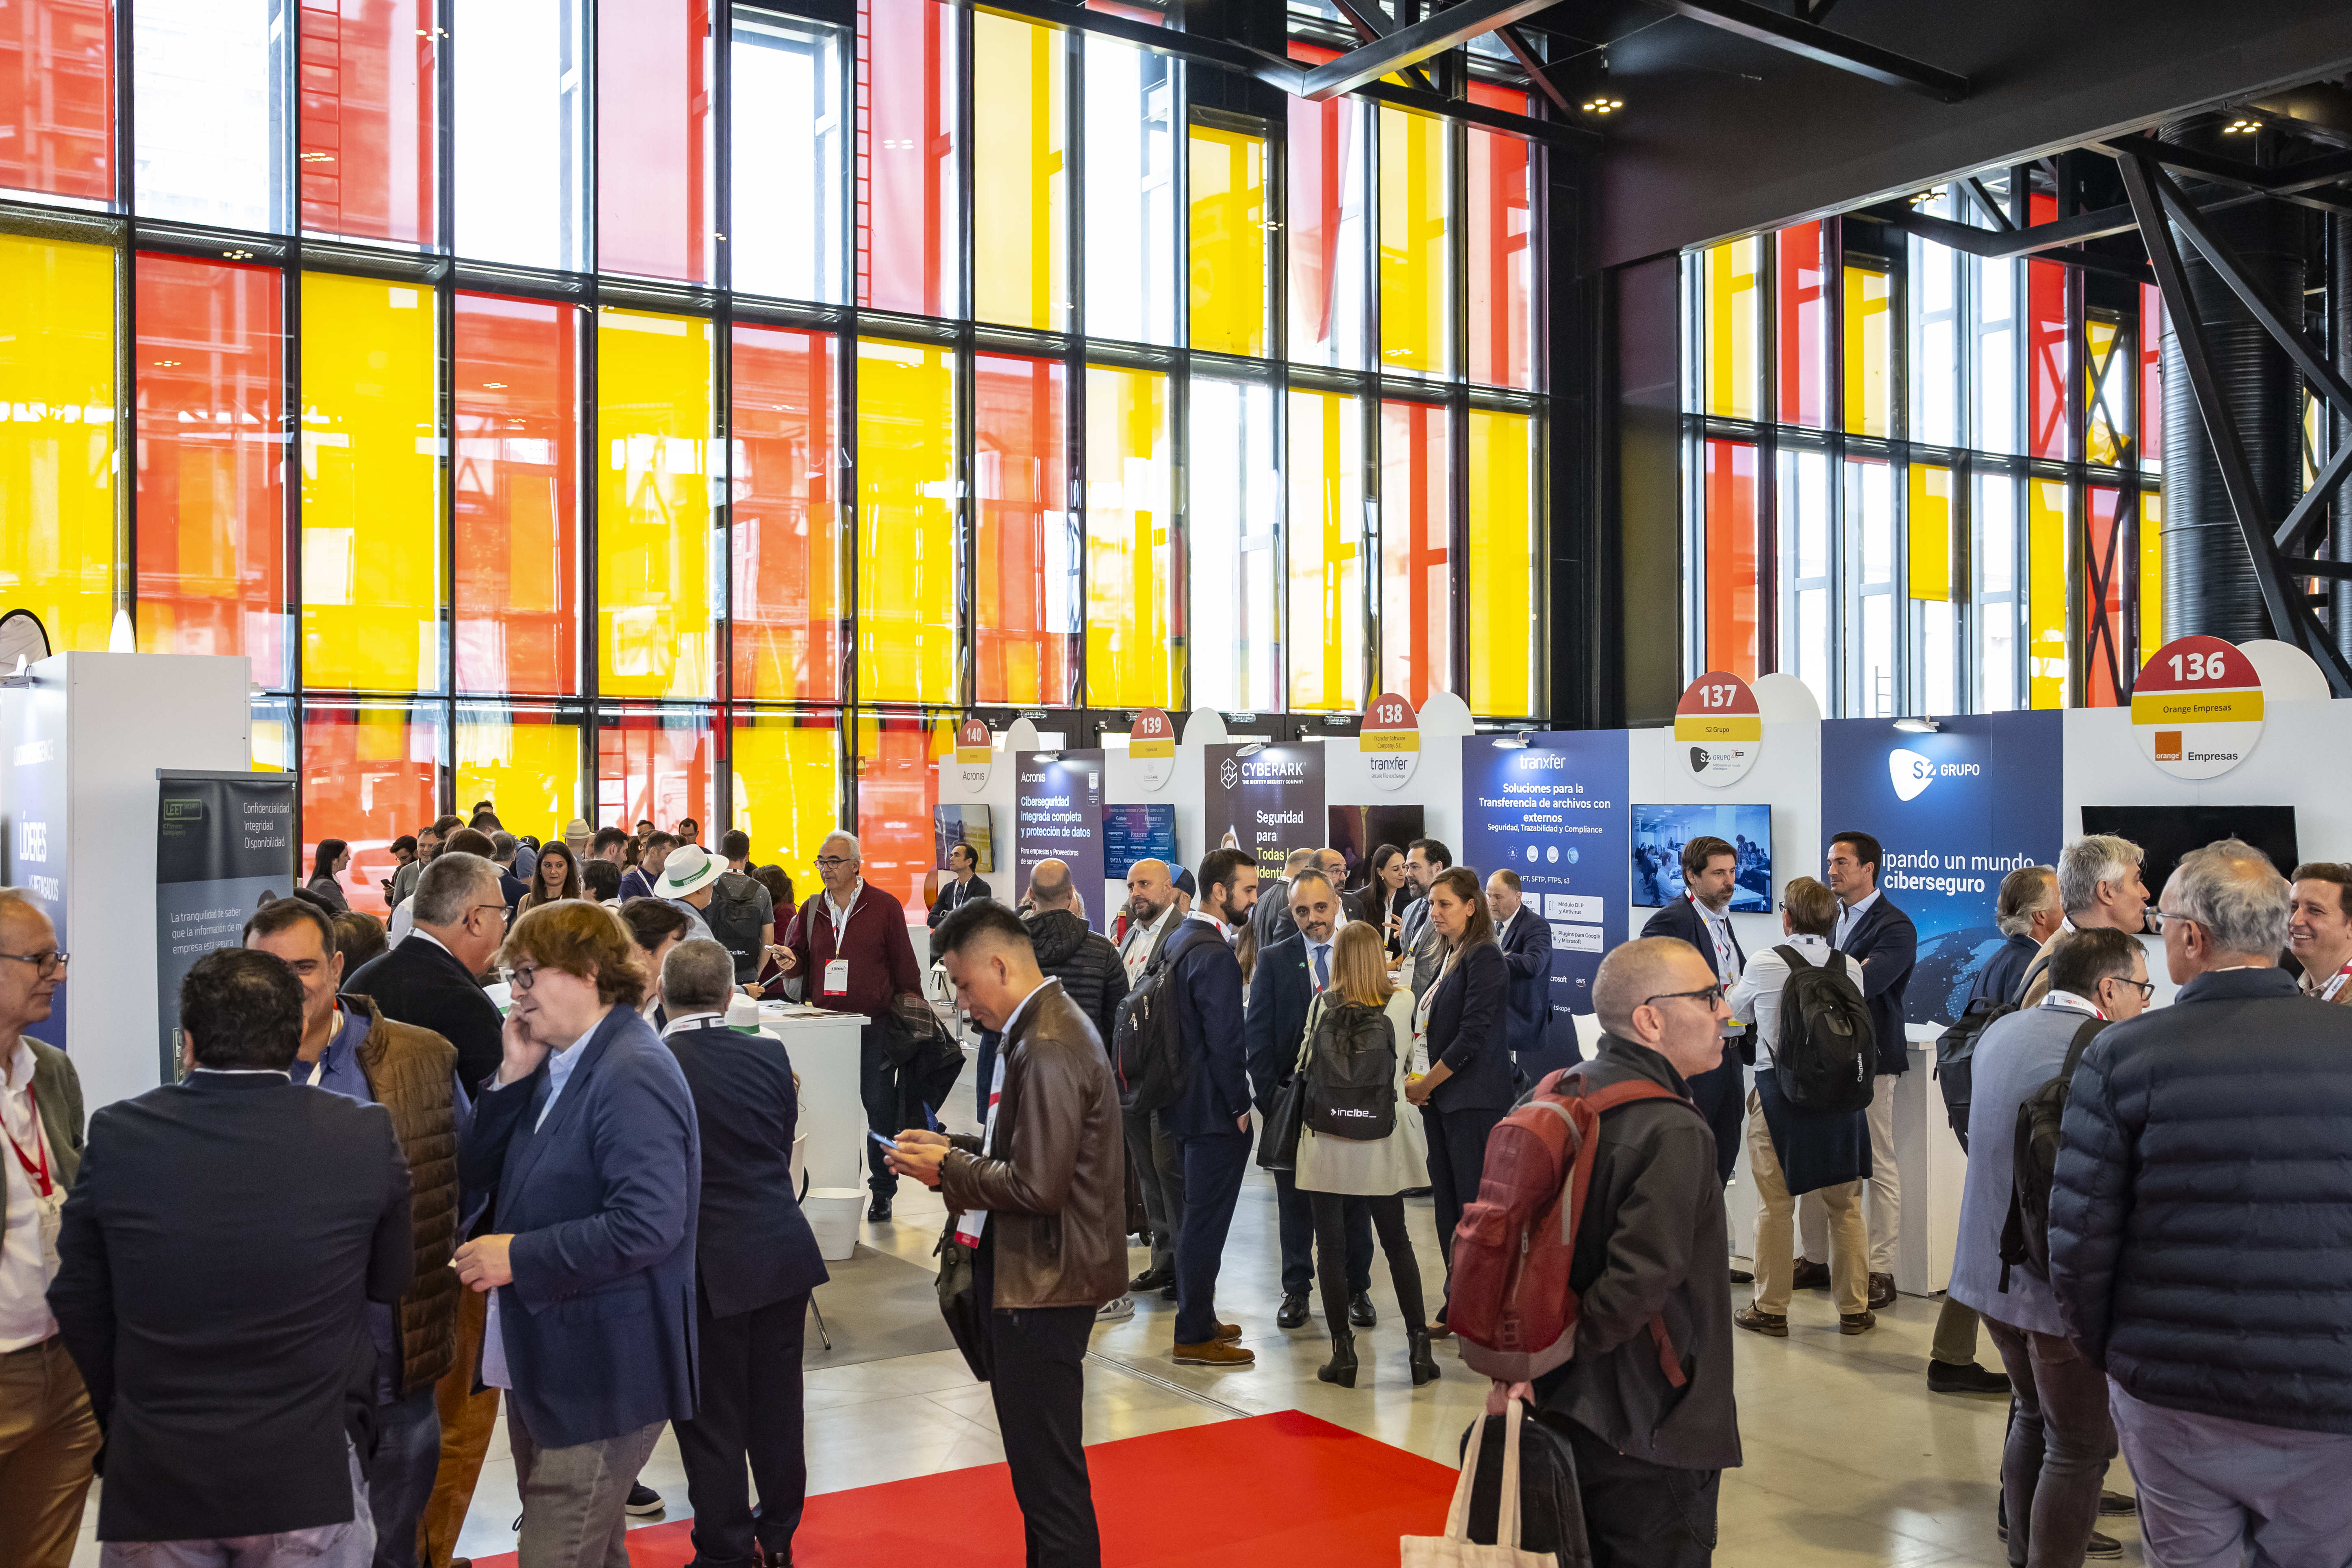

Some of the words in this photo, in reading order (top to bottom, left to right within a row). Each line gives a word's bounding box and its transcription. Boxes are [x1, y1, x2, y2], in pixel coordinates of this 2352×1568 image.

[2167, 651, 2225, 681] 136
[1699, 685, 1737, 707] 137
[1377, 704, 1403, 723] 138
[2163, 706, 2191, 714] Orange
[2193, 705, 2231, 713] Empresas
[1141, 716, 1162, 734] 139
[966, 727, 982, 742] 140
[1370, 756, 1408, 770] tranxfer
[1519, 754, 1566, 769] tranxfer
[1700, 752, 1711, 763] S2
[2188, 752, 2238, 762] Empresas
[963, 770, 985, 781] Acronis
[1241, 761, 1303, 777] CYBERARK
[1913, 761, 1937, 779] S2
[1940, 764, 1980, 776] GRUPO
[1021, 772, 1046, 783] Acronis
[1503, 783, 1551, 794] Soluciones
[1553, 785, 1573, 796] para
[1576, 783, 1584, 794] la
[243, 802, 289, 813] Confidencialidad
[1021, 795, 1069, 809] Ciberseguridad
[1478, 797, 1537, 808] Transferencia
[1539, 798, 1551, 808] de
[1553, 798, 1591, 809] archivos
[1593, 800, 1611, 809] con
[166, 803, 182, 816] LEET
[1021, 811, 1050, 824] integrada
[1051, 811, 1082, 824] completa
[1256, 810, 1304, 826] Seguridad
[1523, 813, 1563, 823] externos
[244, 820, 273, 833] Integridad
[1021, 826, 1025, 838] y
[1026, 825, 1060, 838] protección
[1061, 826, 1070, 837] de
[1072, 826, 1091, 837] datos
[1487, 823, 1519, 833] Seguridad,
[1520, 824, 1558, 833] Trazabilidad
[1564, 825, 1602, 835] Compliance
[20, 810, 47, 863] LÍDERES
[245, 837, 285, 850] Disponibilidad
[1256, 831, 1277, 844] para
[1053, 848, 1079, 856] Proveedores
[1256, 847, 1285, 861] Todas
[1882, 848, 1939, 871] ipando
[1945, 855, 1965, 870] un
[1972, 852, 2035, 872] mundo
[1884, 870, 1985, 896] ciberseguro
[171, 913, 179, 922] La
[181, 909, 217, 922] tranquilidad
[218, 908, 224, 918] de
[225, 907, 241, 918] saber
[172, 930, 185, 941] que
[187, 927, 193, 937] la
[194, 923, 226, 936] información
[227, 922, 235, 932] de
[173, 943, 202, 955] empresa
[204, 939, 215, 950] está
